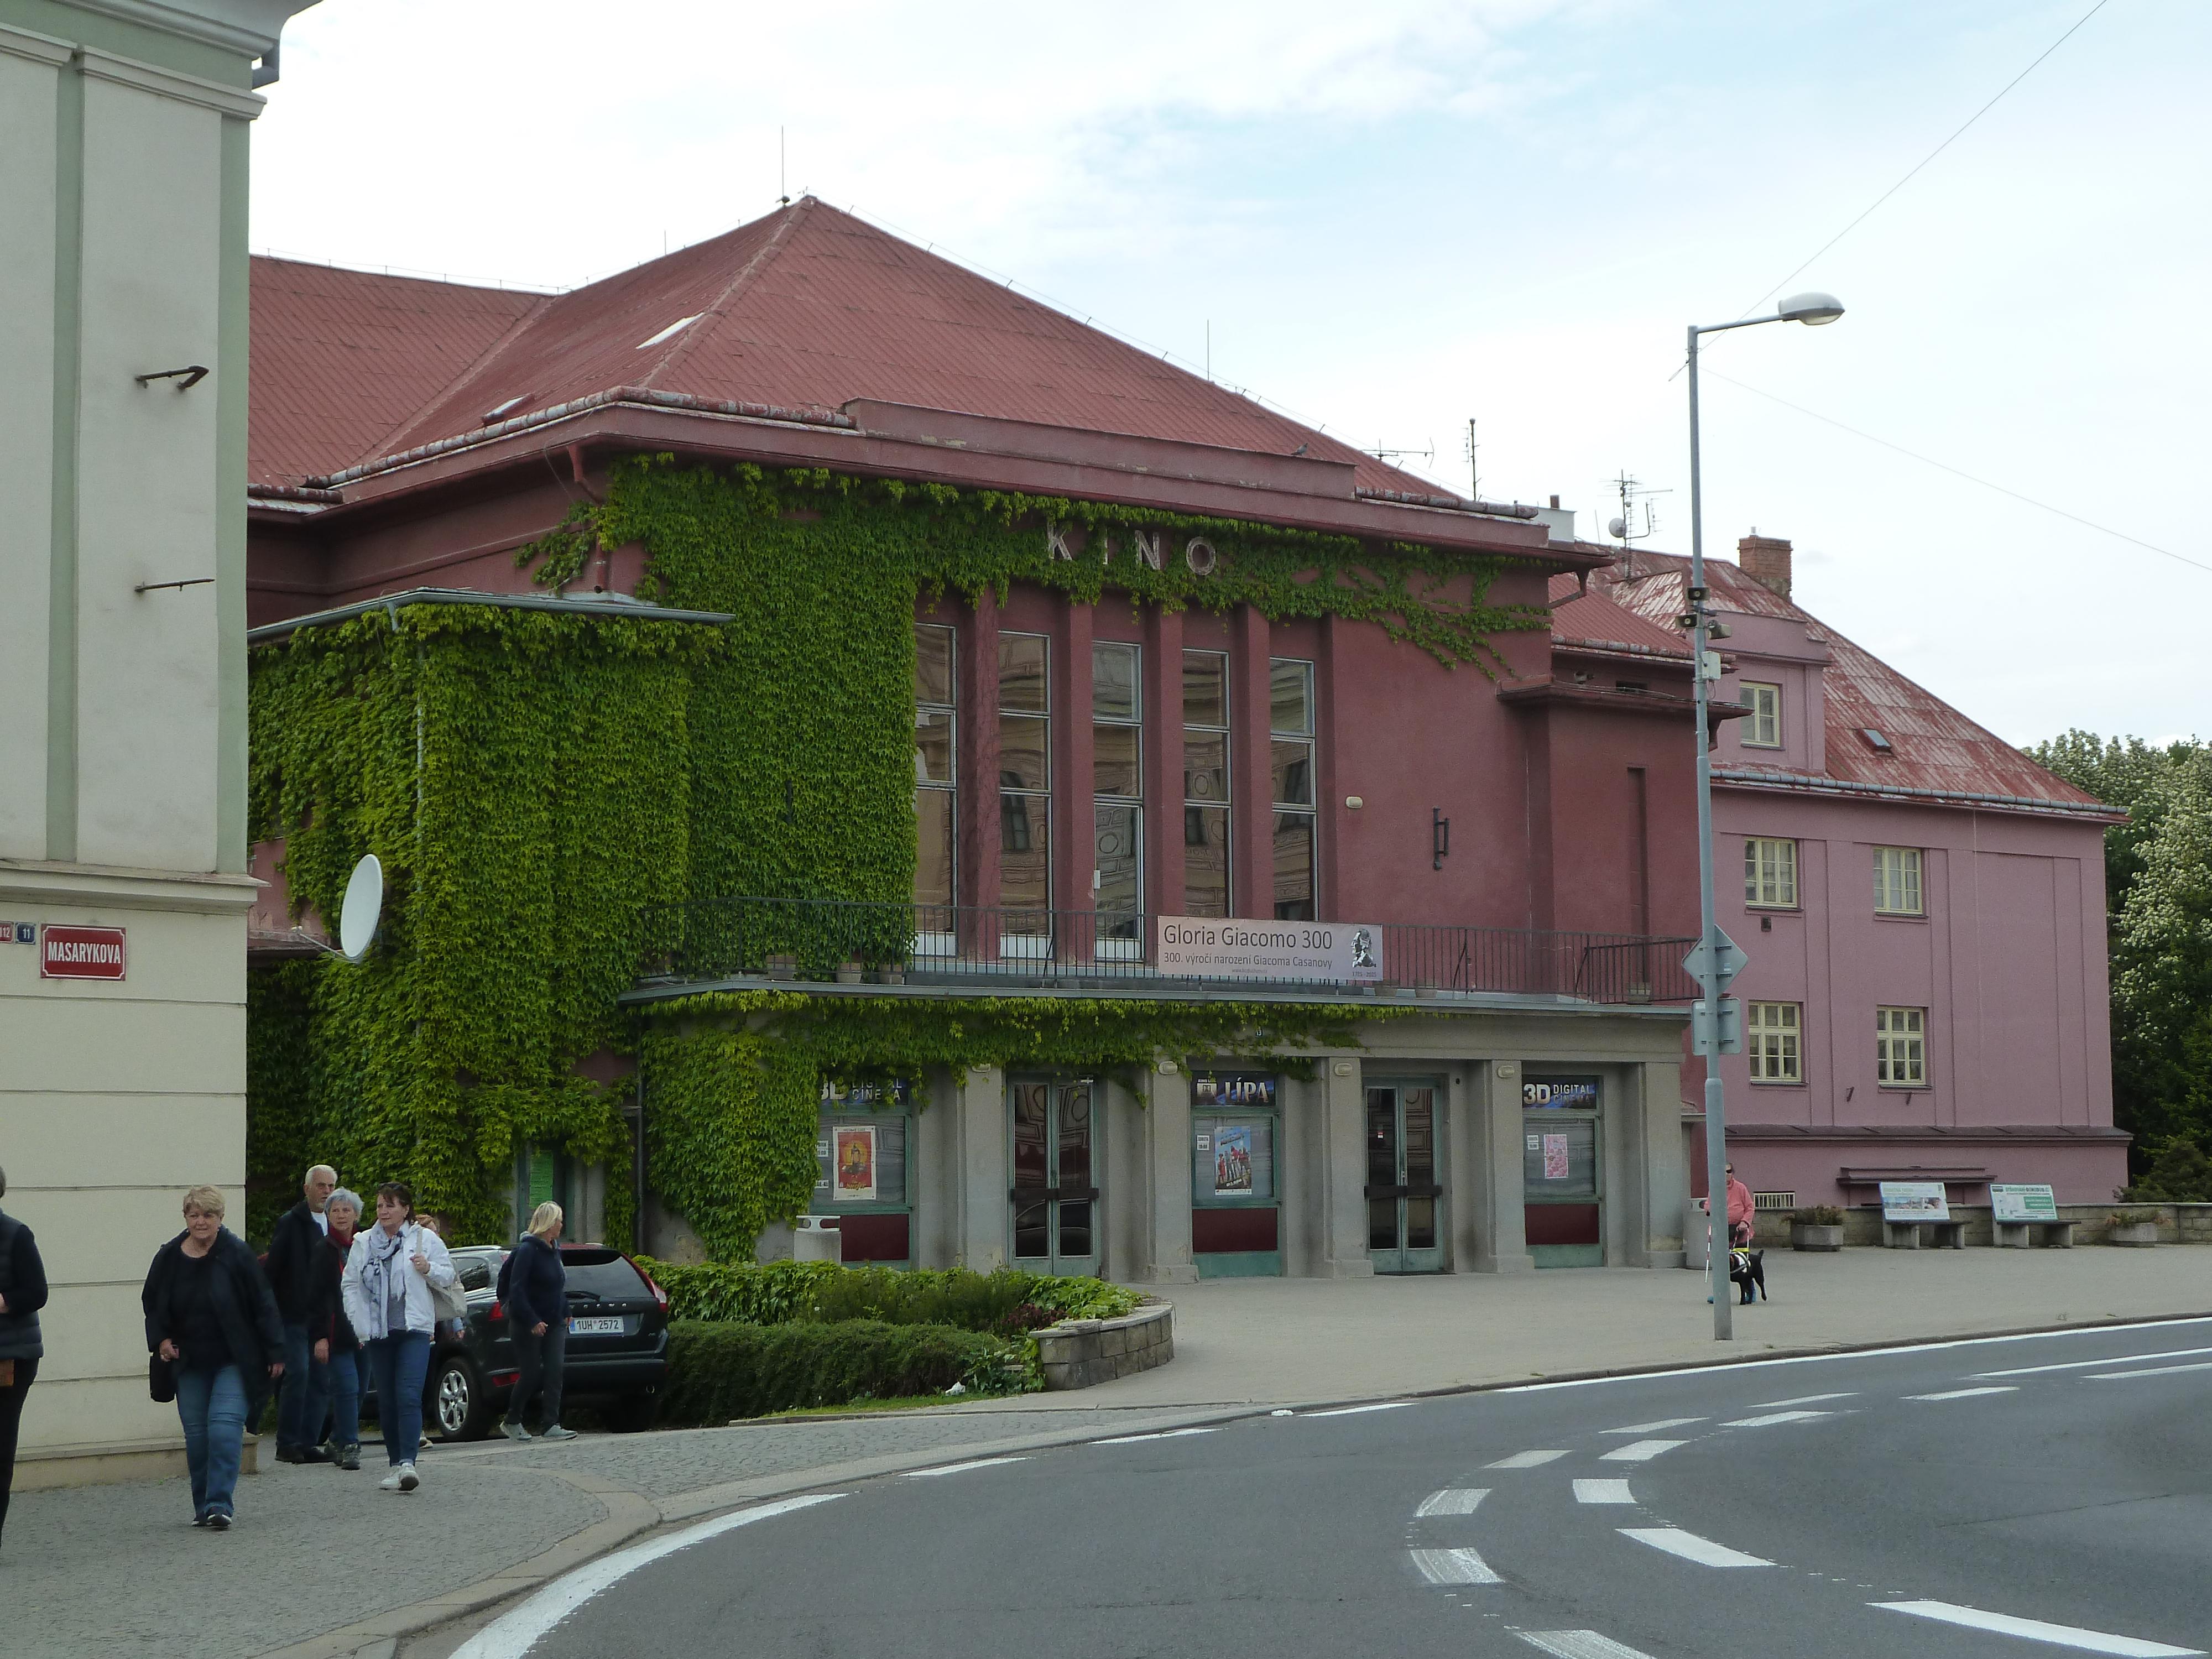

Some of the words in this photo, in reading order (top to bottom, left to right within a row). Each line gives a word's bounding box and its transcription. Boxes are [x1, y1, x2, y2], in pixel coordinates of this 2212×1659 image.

[1047, 522, 1216, 576] KINO
[23, 928, 30, 939] 11
[1164, 924, 1215, 945] Gloria
[1222, 927, 1296, 948] Giacomo
[1302, 930, 1332, 949] 300
[48, 941, 121, 964] MASARYKOVA
[1164, 952, 1183, 963] 300.
[1186, 952, 1212, 966] výročí
[1214, 954, 1251, 964] narození
[1253, 955, 1290, 966] Giacoma
[1293, 957, 1332, 969] Casanovy
[852, 1088, 901, 1100] CINEA
[1225, 1077, 1269, 1103] LÍPA
[1524, 1083, 1551, 1104] 3D
[1553, 1084, 1592, 1094] DIGITAL
[577, 1320, 593, 1330] 1UH
[598, 1319, 619, 1329] 2572
